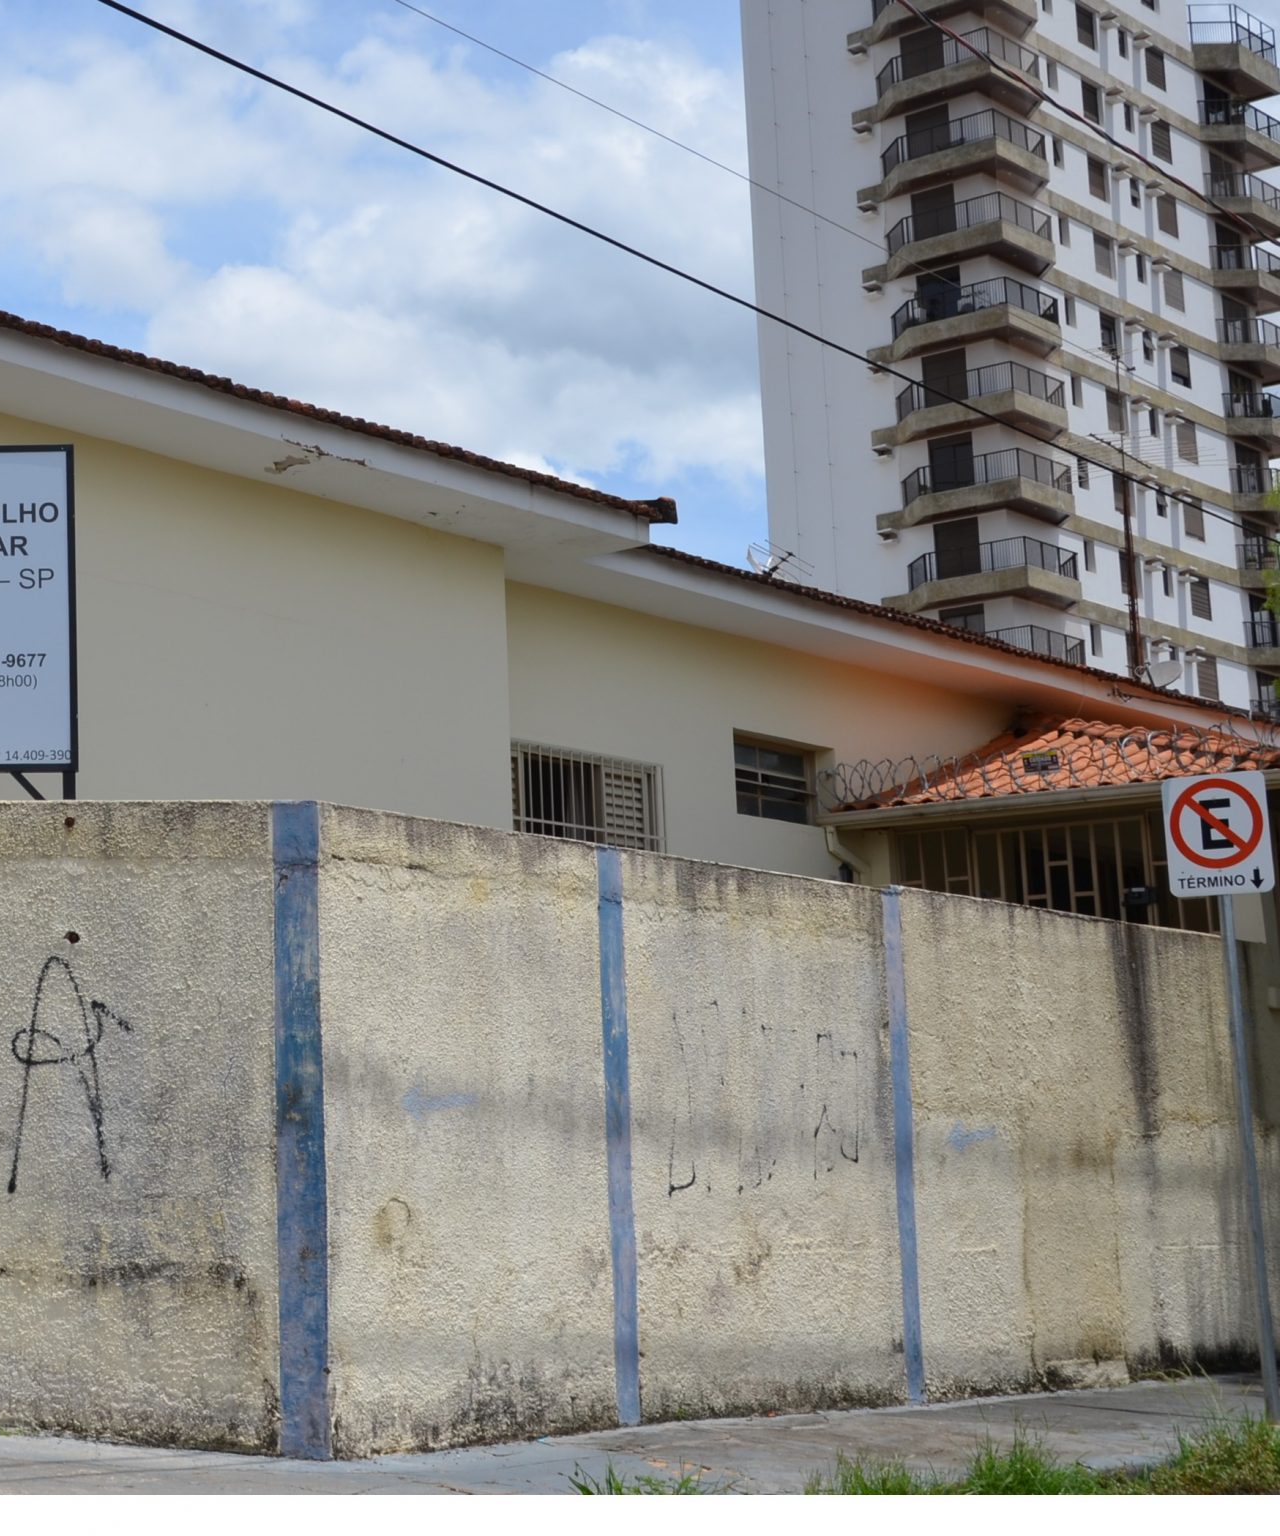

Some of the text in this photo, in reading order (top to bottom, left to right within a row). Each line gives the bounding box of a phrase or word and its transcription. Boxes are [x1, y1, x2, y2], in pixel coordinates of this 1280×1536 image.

[19, 568, 55, 589] SP
[5, 749, 71, 762] 14.409-390
[1199, 798, 1234, 850] E
[1178, 874, 1246, 889] TÉRMINO
